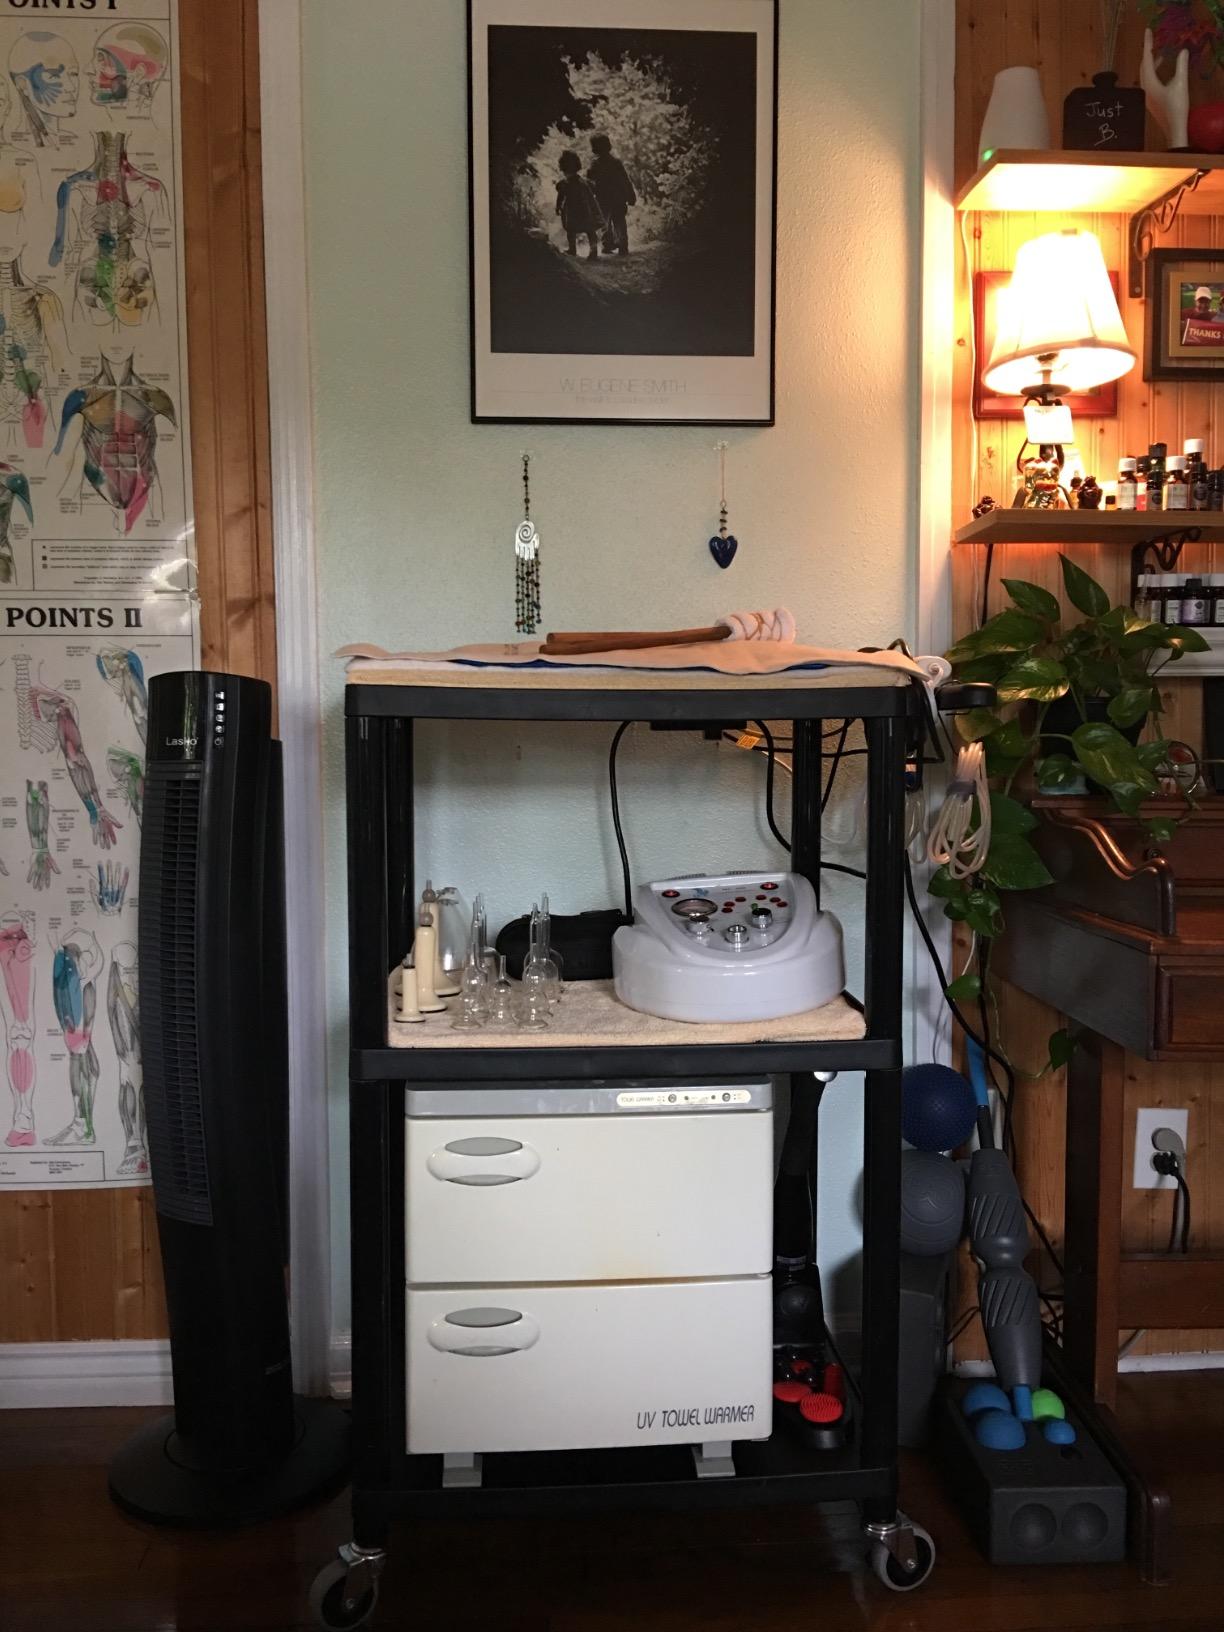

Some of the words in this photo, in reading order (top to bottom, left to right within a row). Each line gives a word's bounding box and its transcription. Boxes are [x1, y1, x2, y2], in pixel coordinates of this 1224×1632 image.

[1085, 101, 1125, 118] Just
[1189, 327, 1222, 339] THANKS
[5, 607, 114, 628] POINTS
[124, 608, 143, 628] II
[637, 1411, 656, 1429] UV
[662, 1408, 701, 1427] TOWEL
[704, 1404, 755, 1425] WARMER
